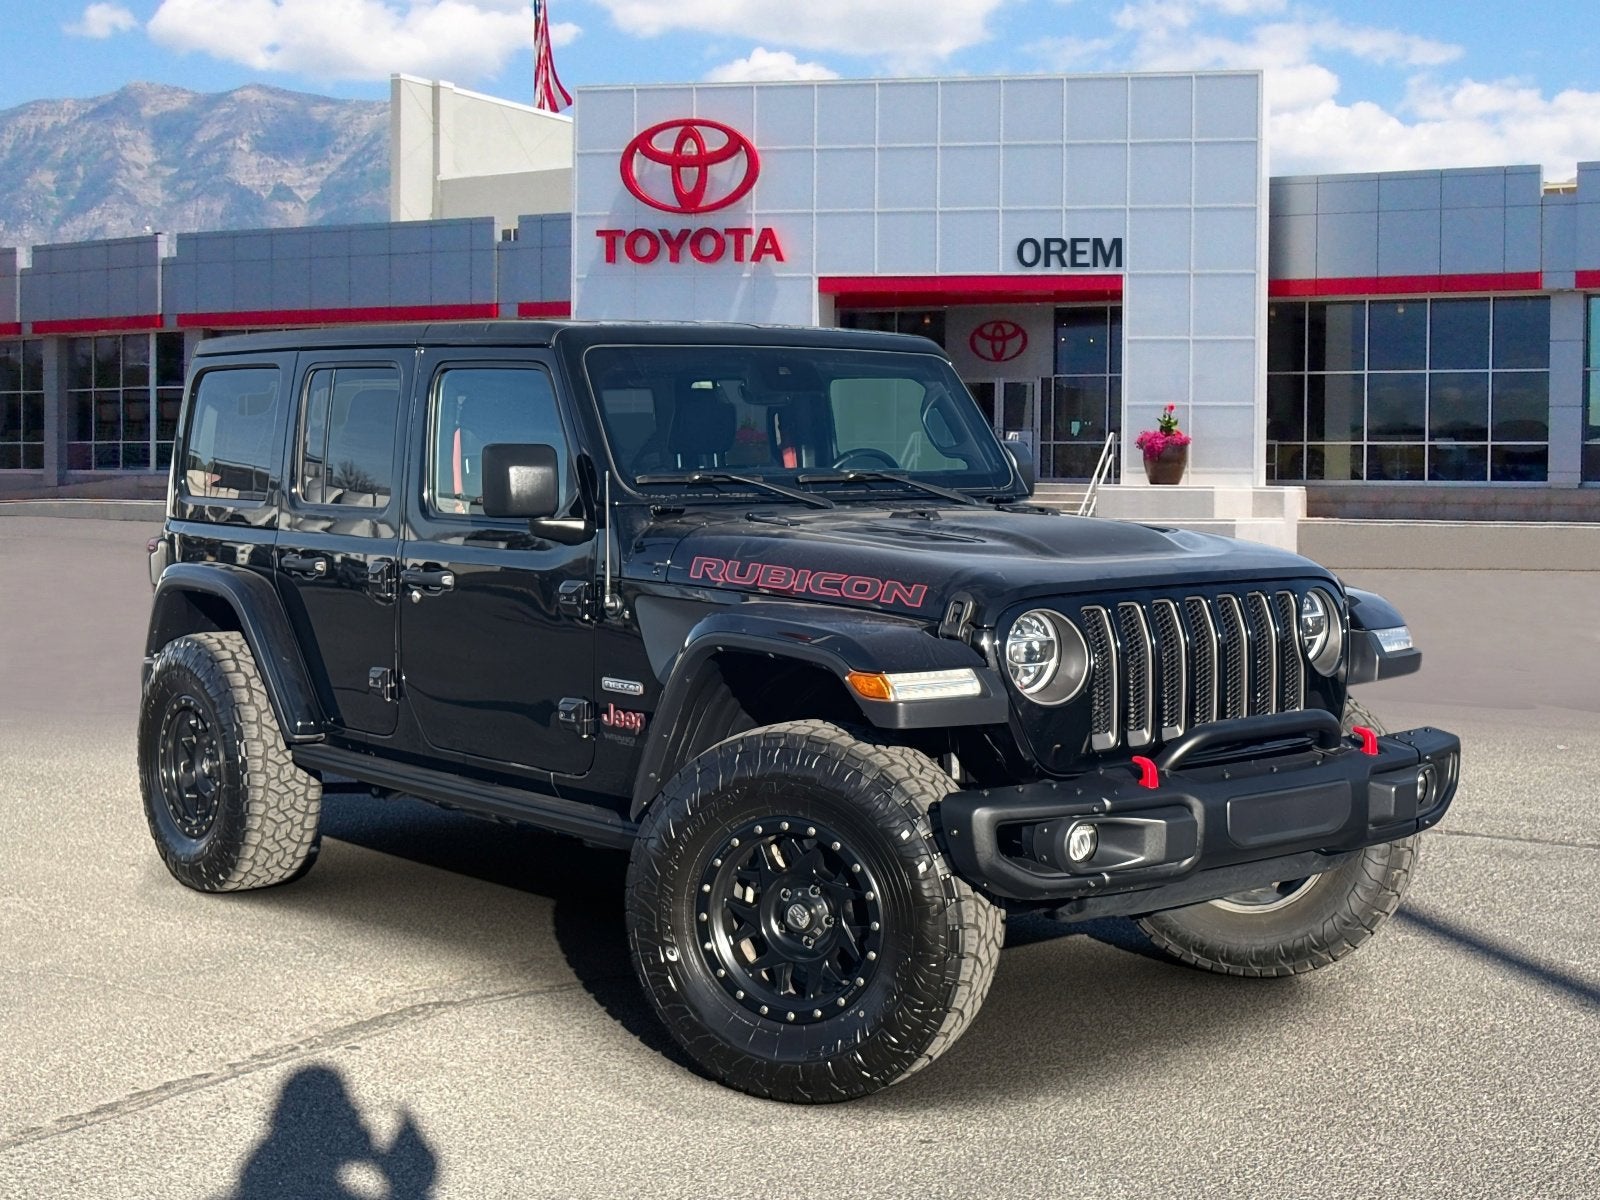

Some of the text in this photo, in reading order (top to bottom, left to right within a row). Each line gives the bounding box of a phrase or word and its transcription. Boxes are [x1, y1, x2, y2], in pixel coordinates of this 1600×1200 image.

[596, 227, 784, 264] TOYOTA
[1016, 237, 1123, 268] OREM
[690, 556, 928, 608] RUBICON
[601, 702, 646, 735] Jeep
